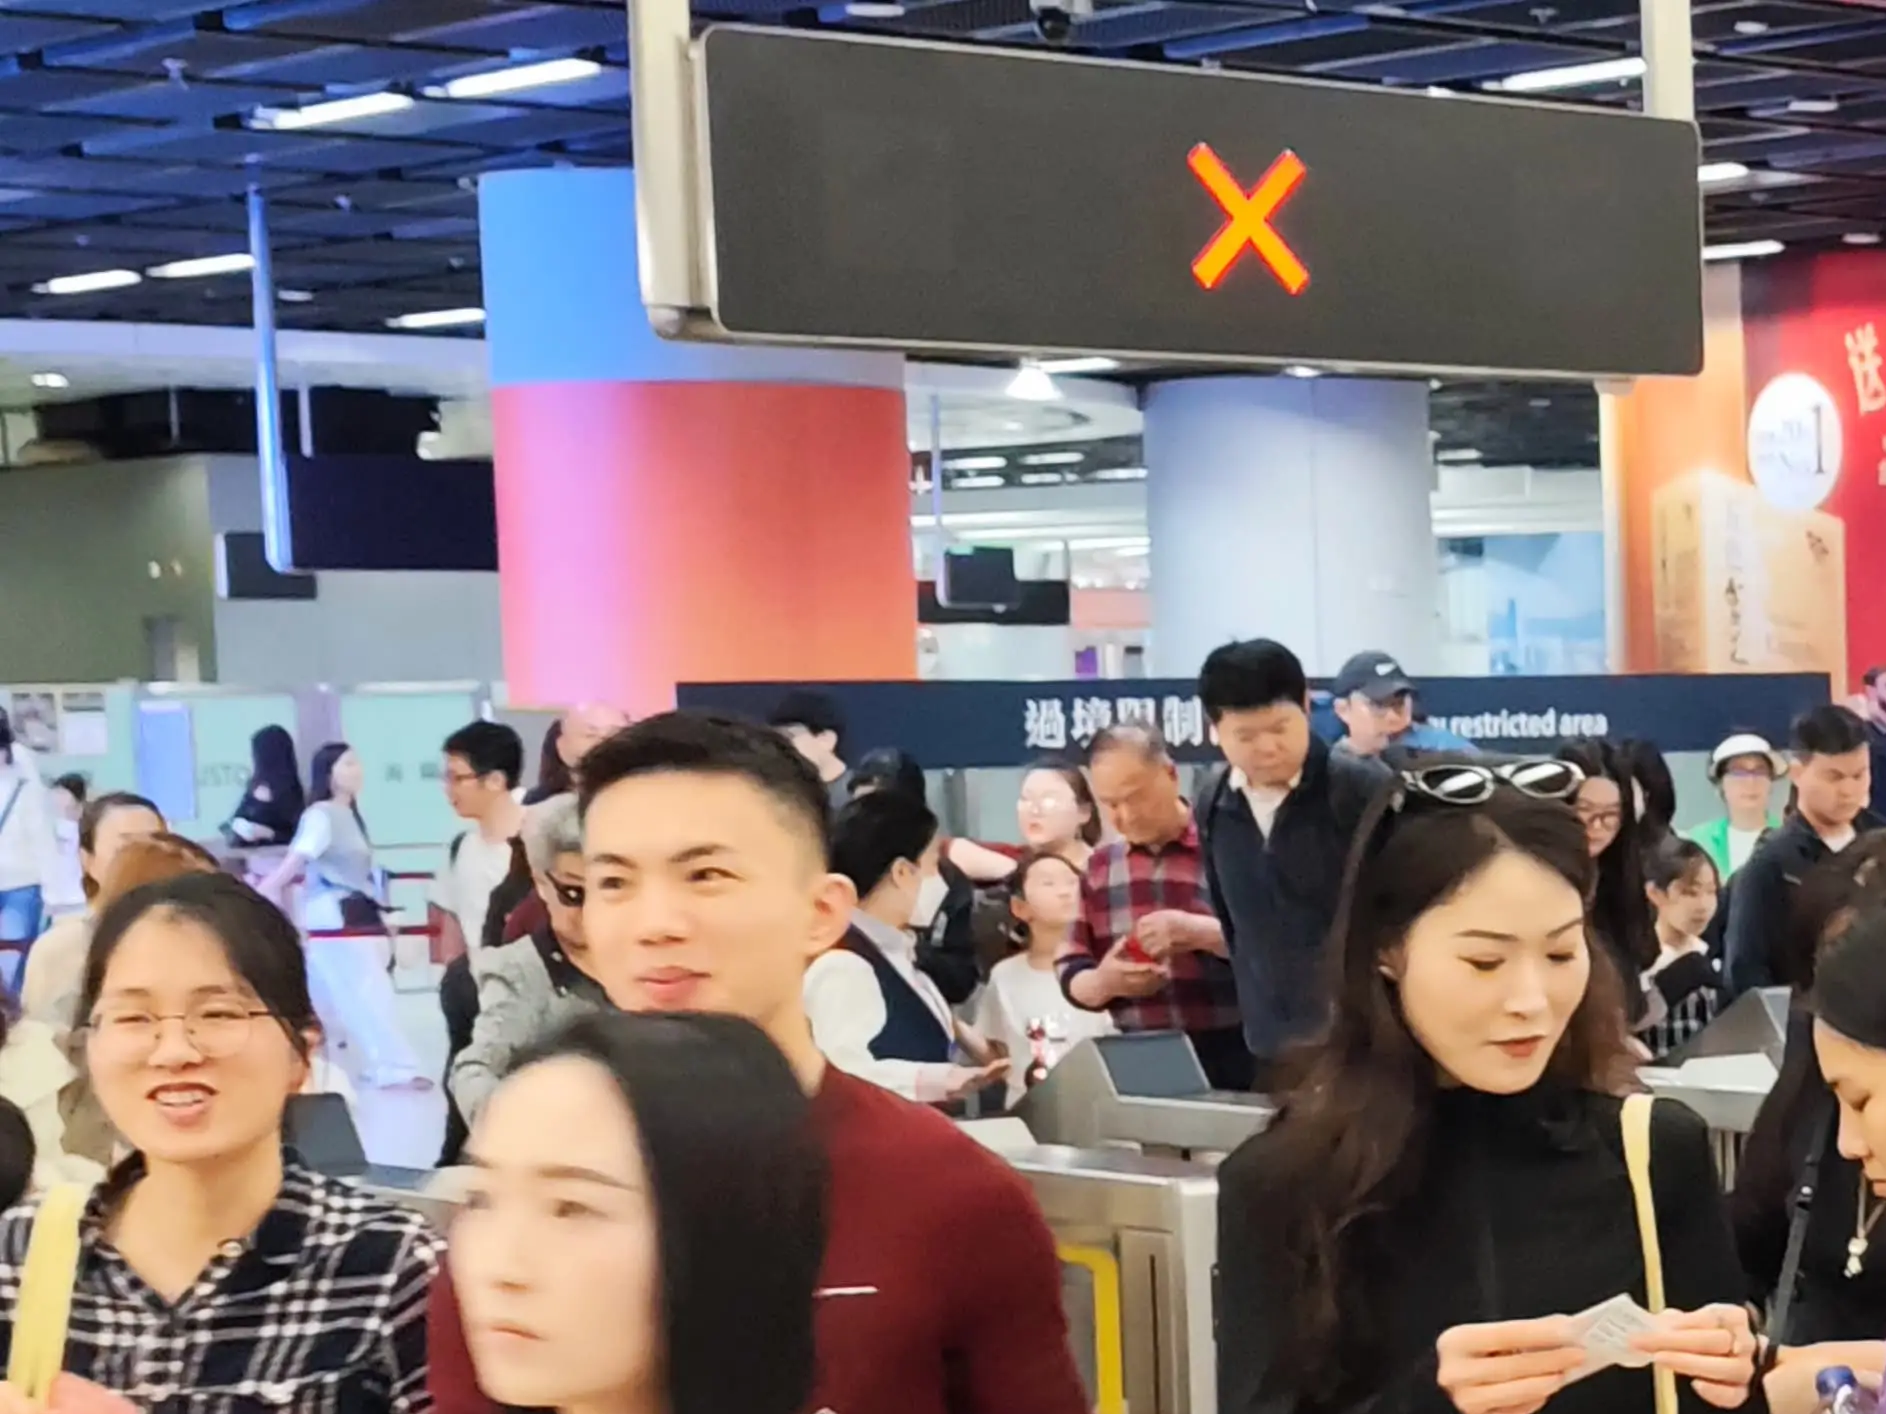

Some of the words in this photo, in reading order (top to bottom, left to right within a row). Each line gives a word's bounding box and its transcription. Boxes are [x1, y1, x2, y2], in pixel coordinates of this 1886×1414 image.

[1024, 695, 1219, 748] 過境限制
[1451, 706, 1556, 739] restricted
[1559, 713, 1609, 738] area
